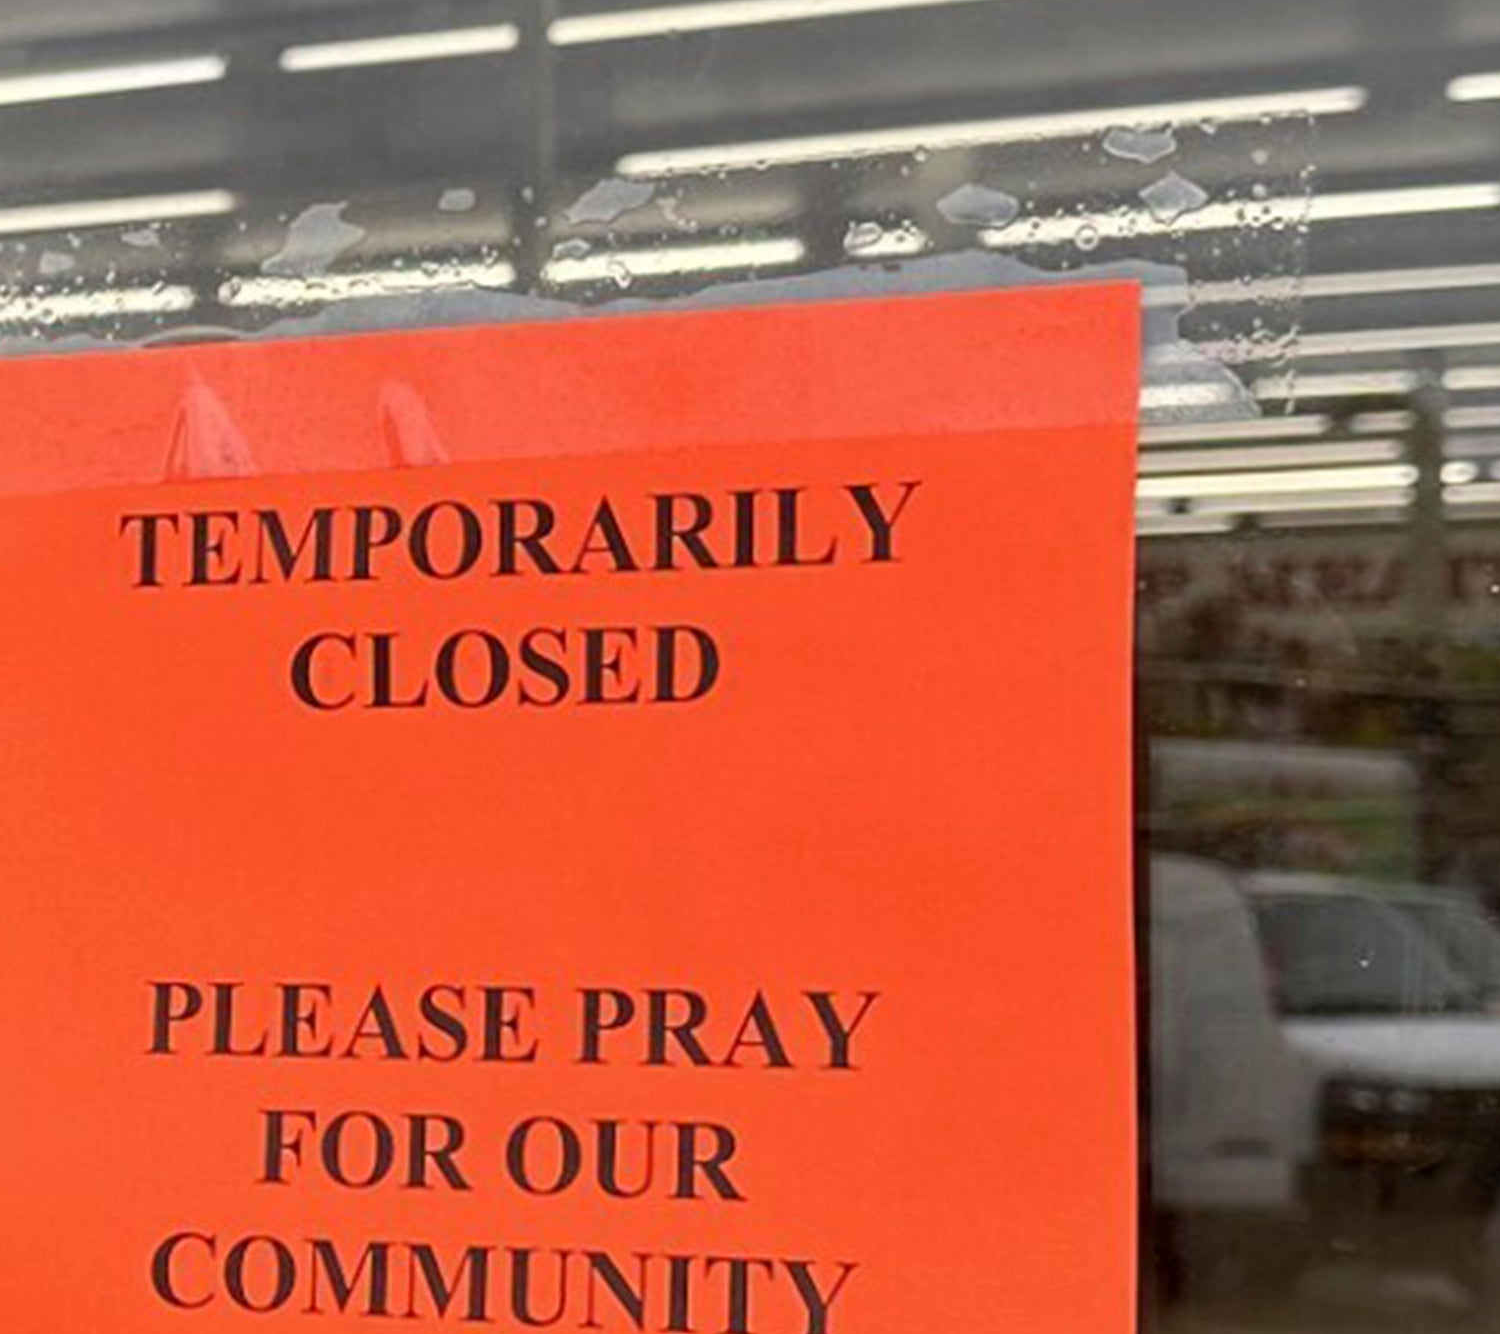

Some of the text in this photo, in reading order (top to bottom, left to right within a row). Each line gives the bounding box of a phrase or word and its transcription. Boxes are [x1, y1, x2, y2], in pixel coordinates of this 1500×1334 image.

[120, 481, 920, 587] TEMPORARILY
[289, 624, 721, 711] CLOSED
[147, 979, 880, 1070] PLEASE PRAY
[255, 1107, 747, 1203] FOR OUR
